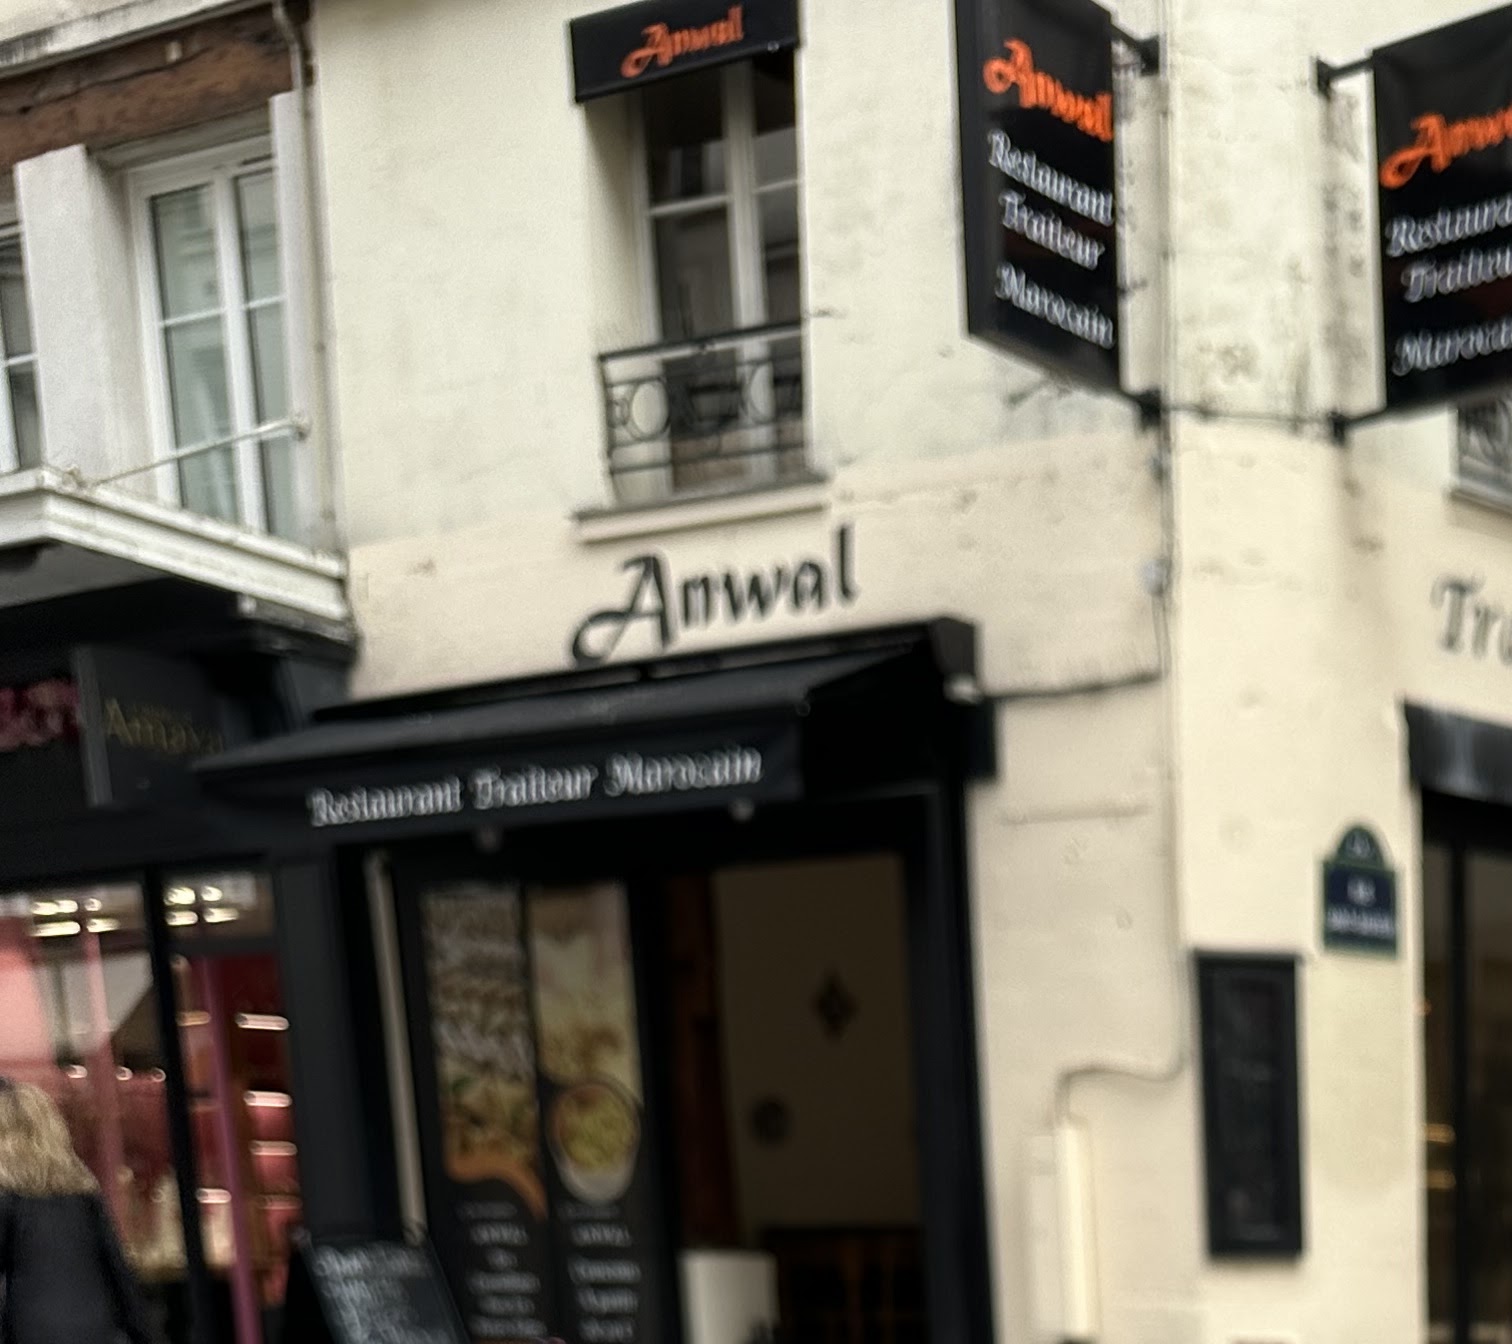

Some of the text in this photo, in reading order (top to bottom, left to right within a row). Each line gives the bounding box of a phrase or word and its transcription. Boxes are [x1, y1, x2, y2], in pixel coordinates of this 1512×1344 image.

[987, 127, 1114, 227] Restaurant
[999, 188, 1106, 271] Traiteur
[995, 261, 1116, 349] Marocain
[571, 523, 860, 667] Anwal
[307, 745, 764, 827] Restaurant Traiteur Marocain
